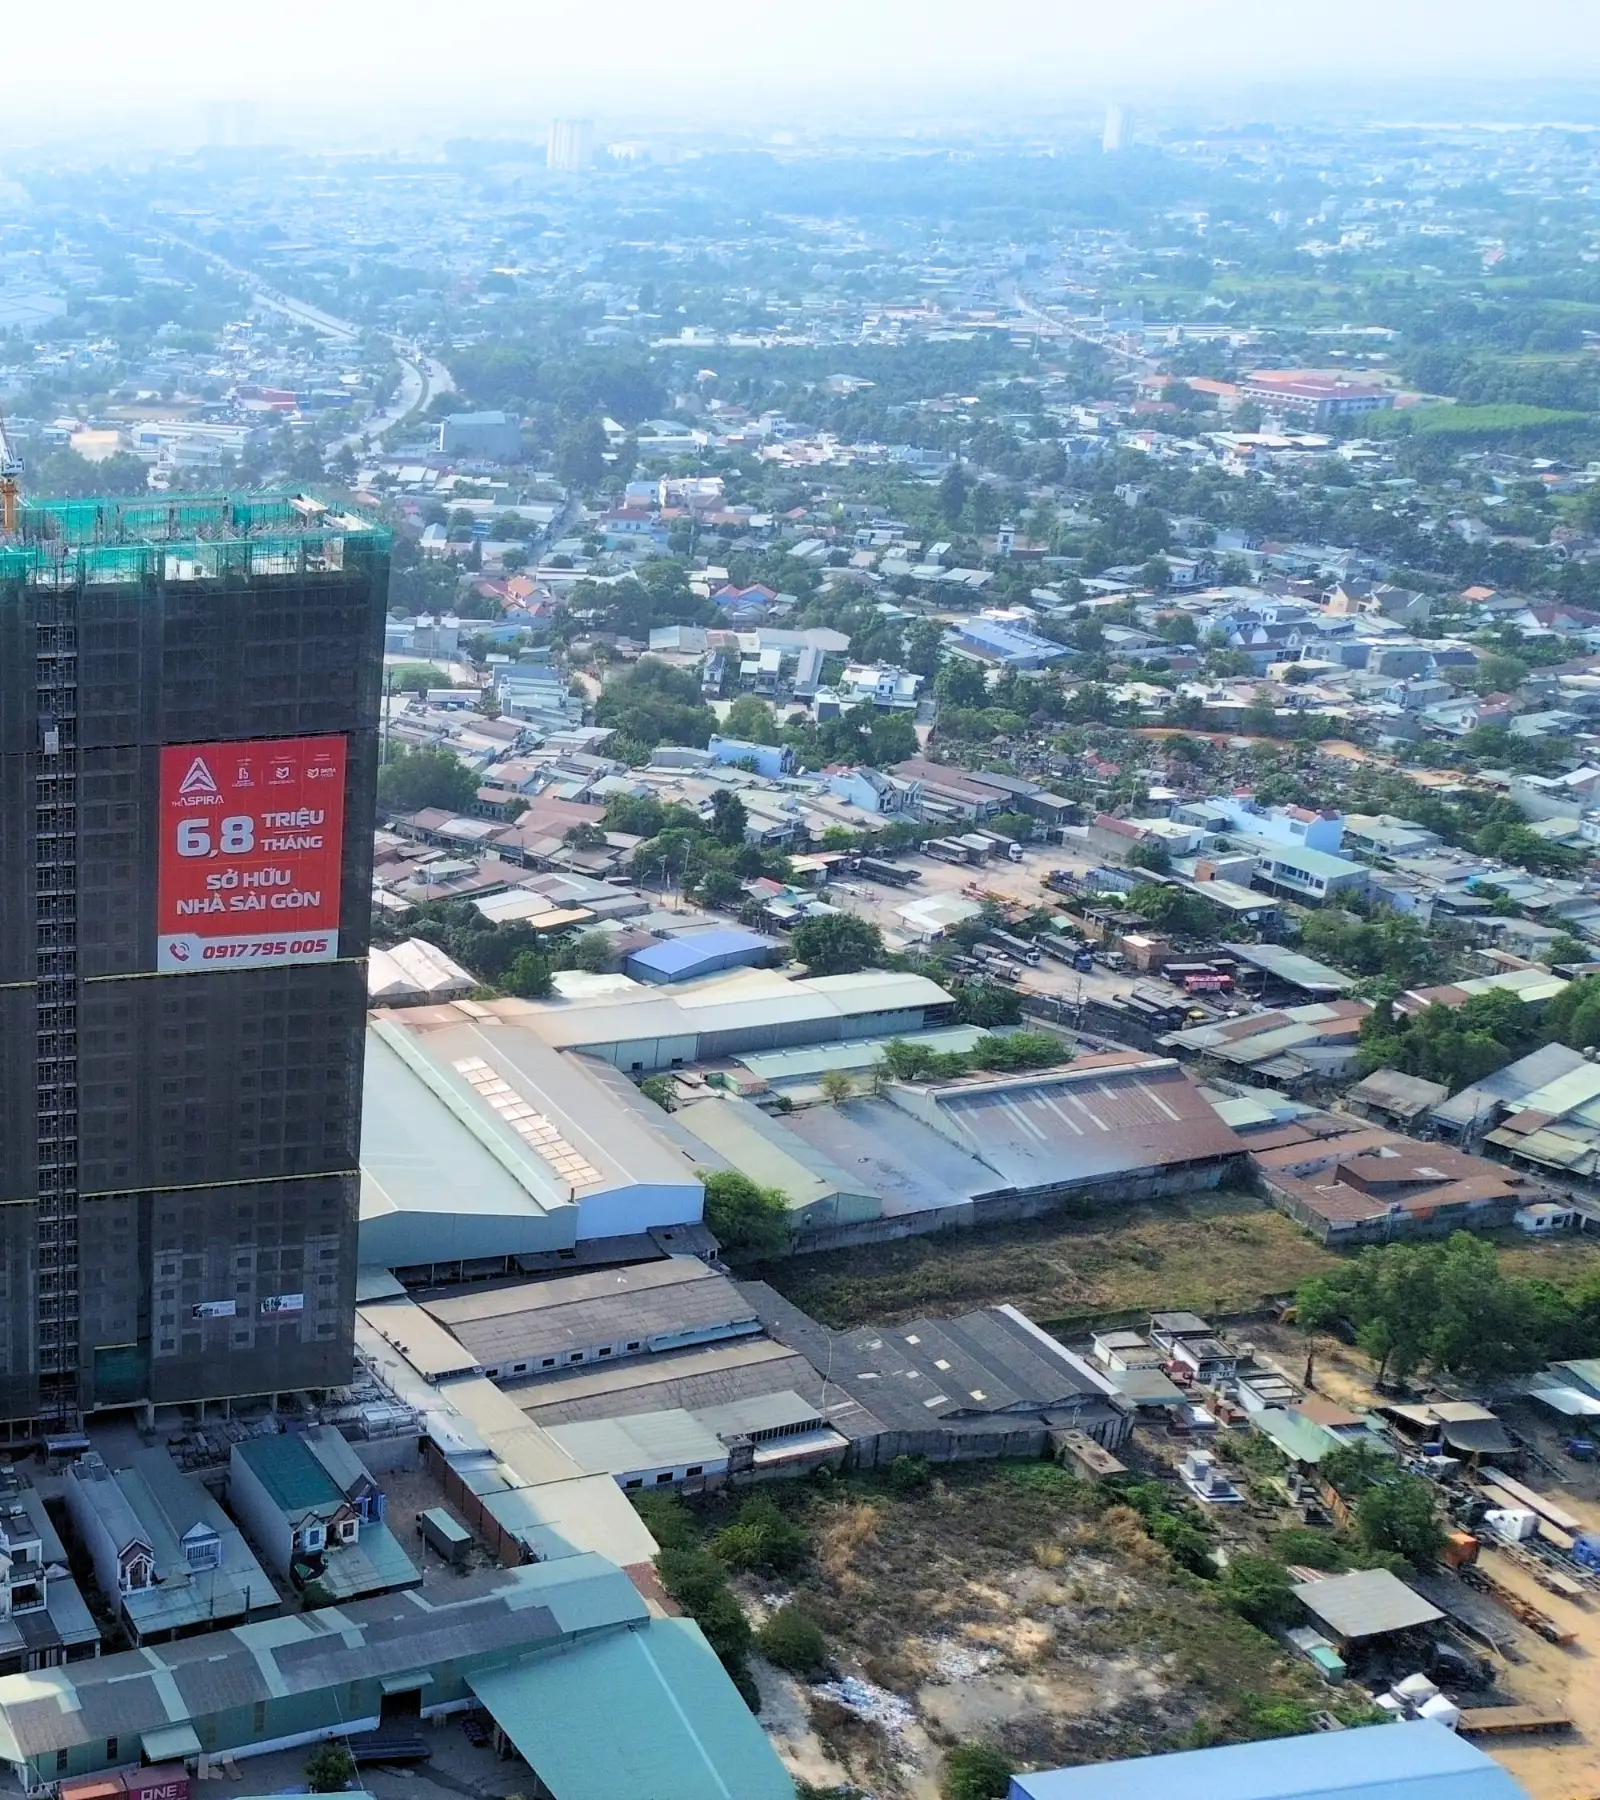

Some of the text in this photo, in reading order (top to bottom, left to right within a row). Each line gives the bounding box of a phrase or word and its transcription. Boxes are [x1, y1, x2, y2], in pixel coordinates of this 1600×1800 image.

[181, 794, 224, 807] ASPIRA
[261, 807, 324, 829] TRIỆU
[176, 815, 254, 858] 6,8
[260, 835, 323, 852] THÁNG
[206, 867, 291, 890] SỞ HỮU
[176, 888, 321, 916] NHÀ SÀI GÒN
[202, 938, 328, 960] 0917 795 005
[140, 1785, 177, 1800] ONE
